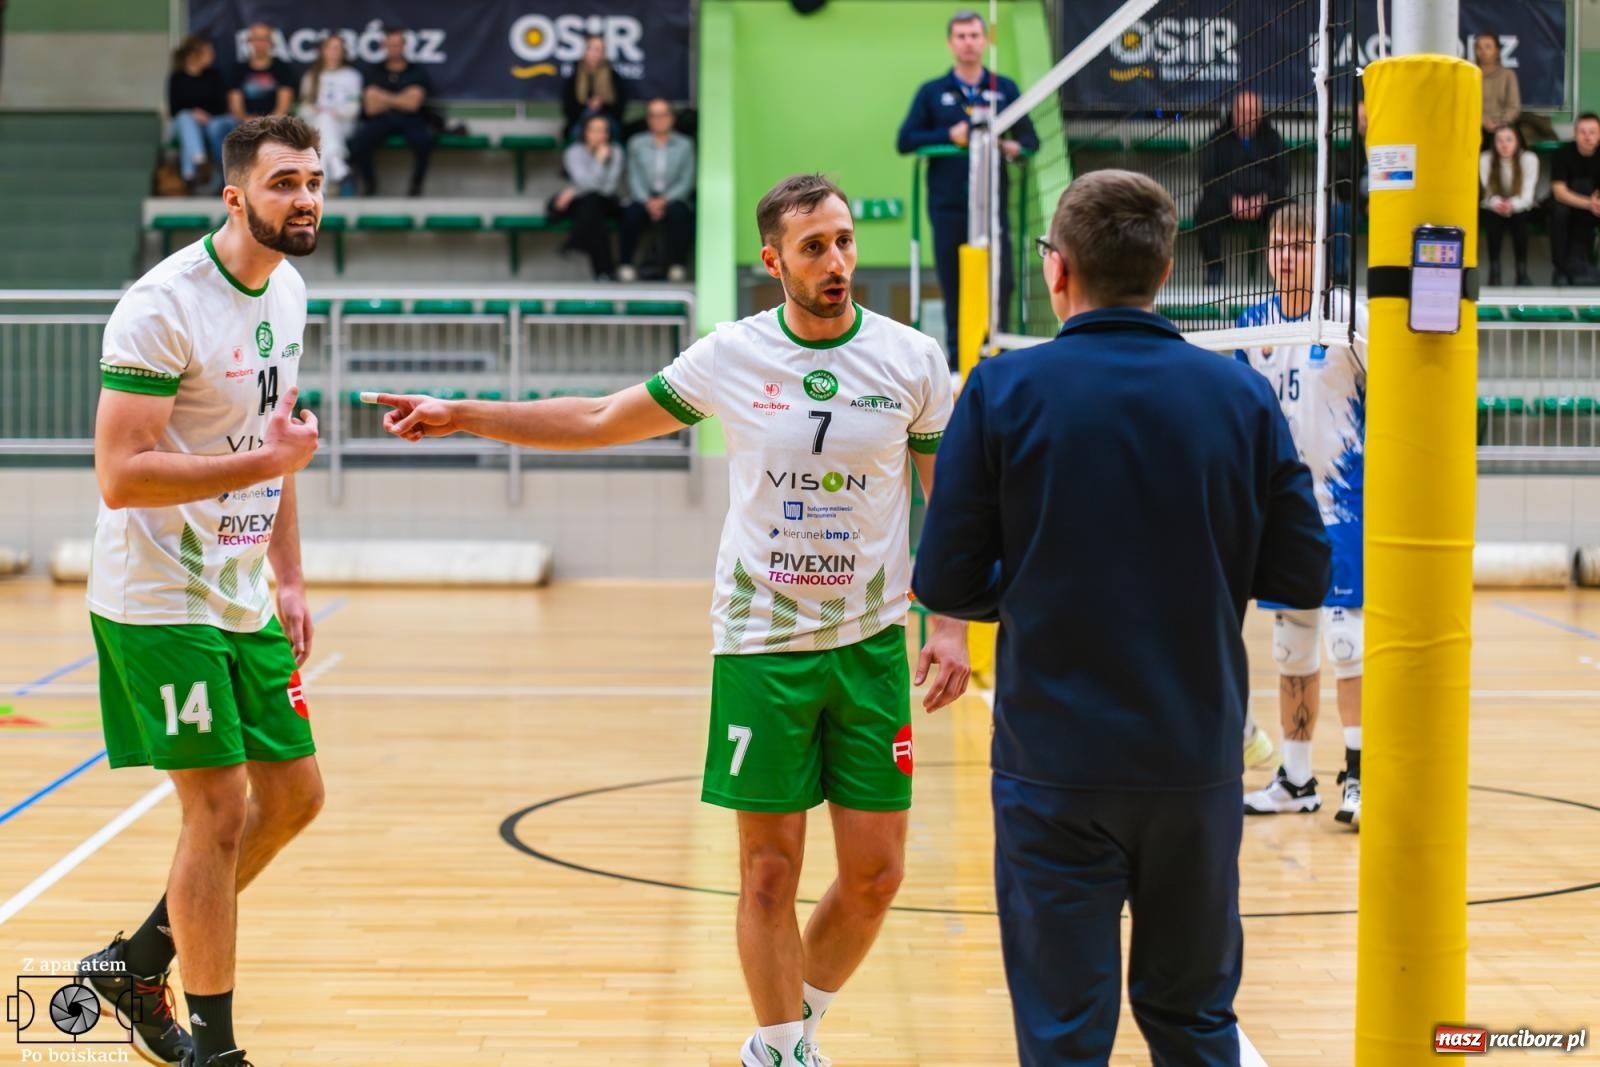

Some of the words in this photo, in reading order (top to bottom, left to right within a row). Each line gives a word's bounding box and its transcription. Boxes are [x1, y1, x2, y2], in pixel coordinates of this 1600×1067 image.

[257, 366, 278, 416] 14
[752, 401, 790, 411] Racibórz
[808, 410, 832, 455] 7
[766, 470, 866, 493] VISON
[218, 514, 275, 533] PIVEX
[783, 528, 861, 542] kierunekbmp.pl
[769, 551, 856, 573] PIVEXIN
[768, 571, 854, 585] TECHNOLOGY
[160, 681, 213, 736] 14
[728, 724, 752, 777] 7
